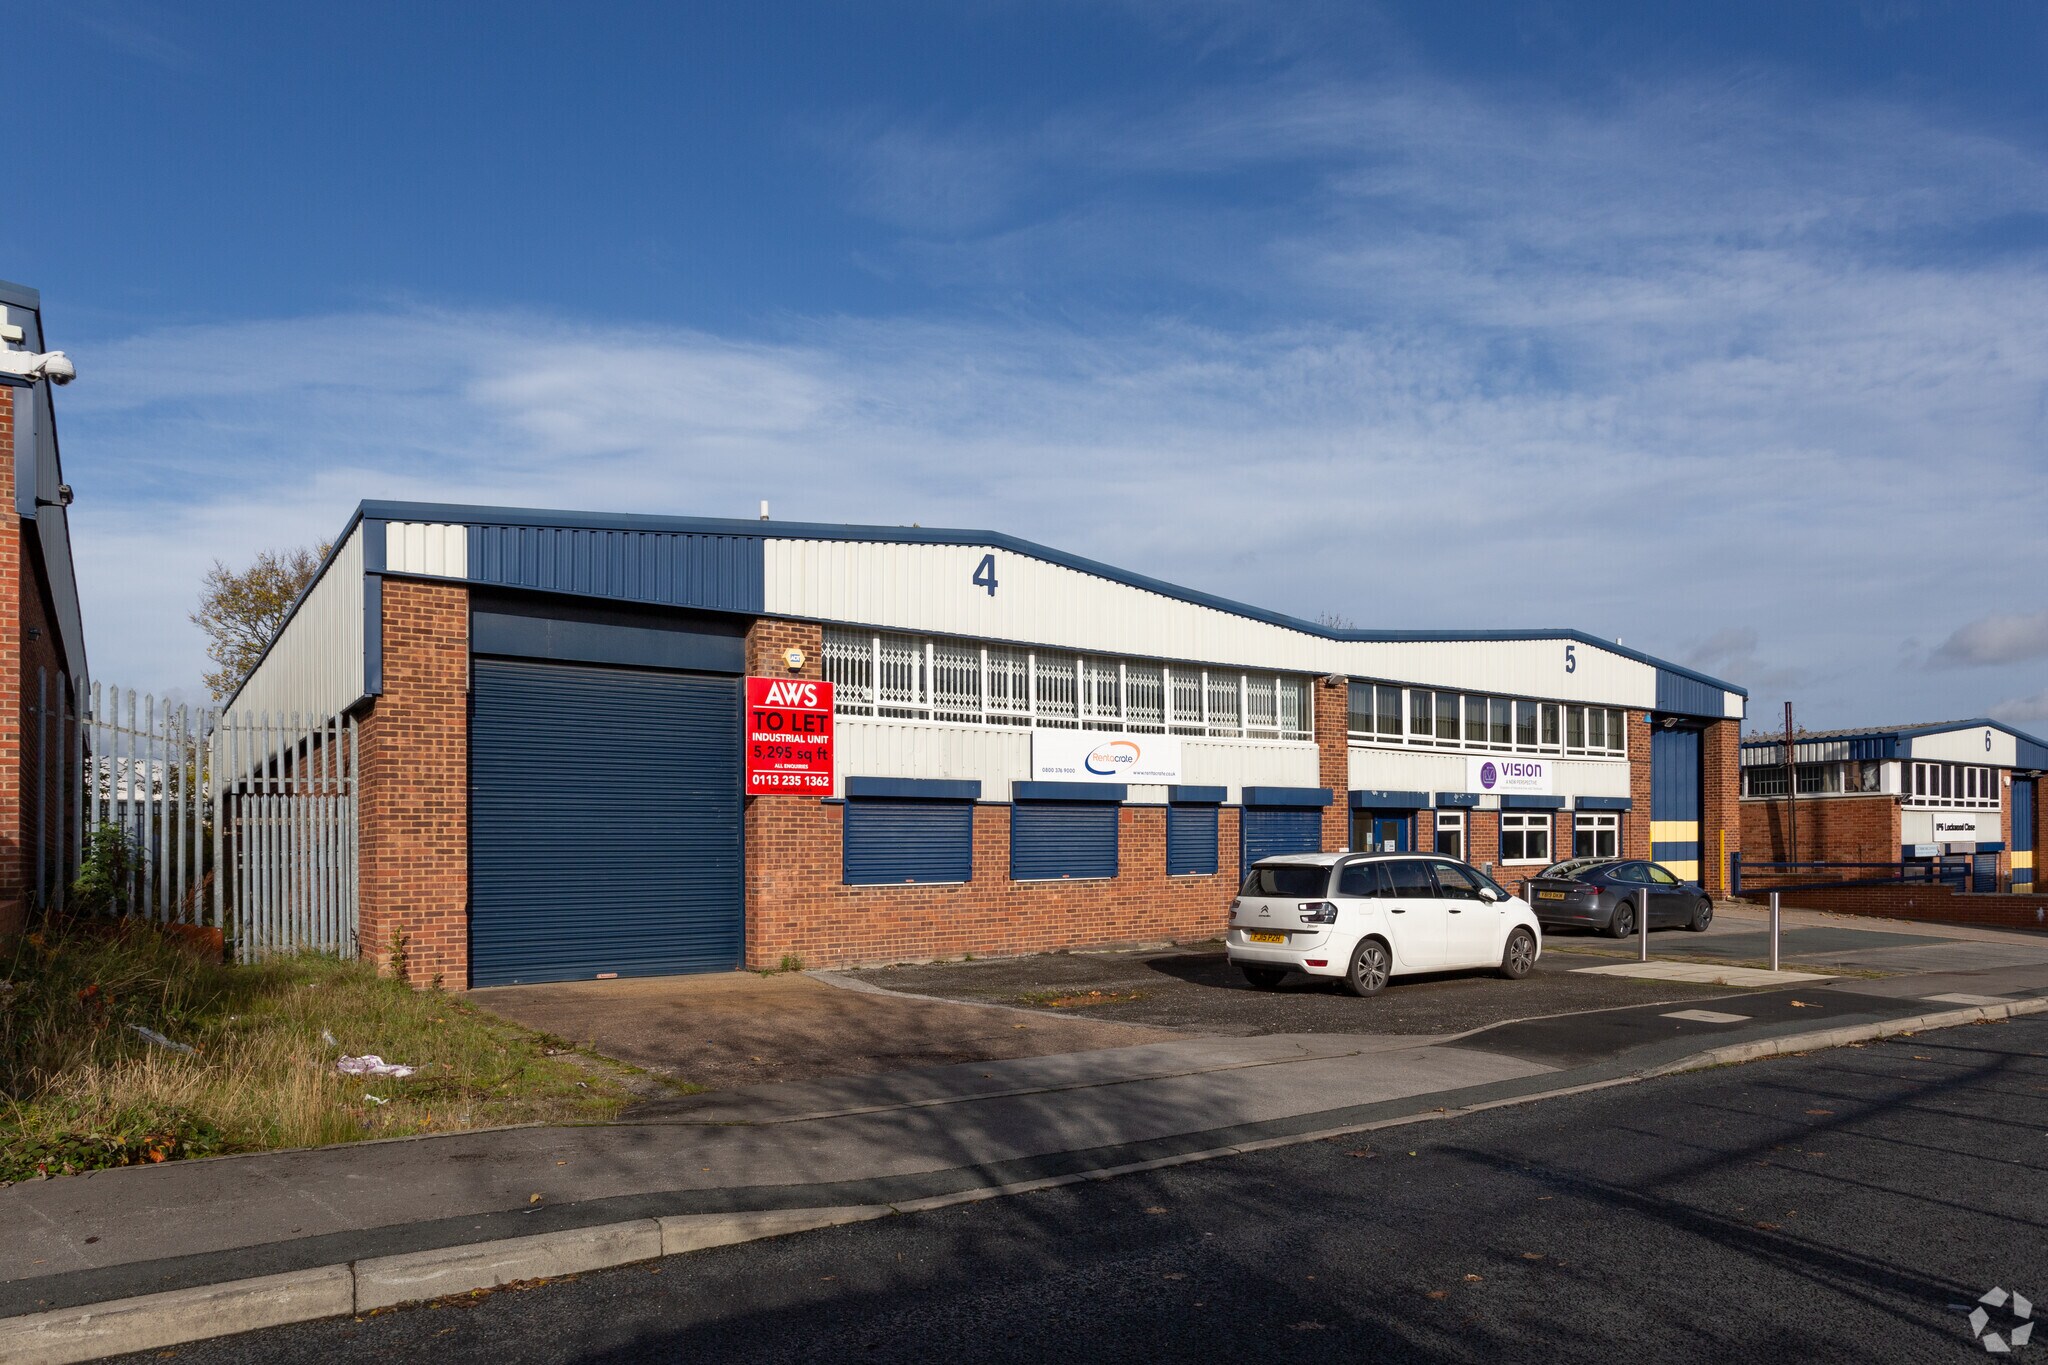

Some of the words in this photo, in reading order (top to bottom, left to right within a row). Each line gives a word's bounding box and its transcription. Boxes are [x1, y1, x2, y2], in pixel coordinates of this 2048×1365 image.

[973, 554, 998, 597] 4
[1566, 645, 1576, 674] 5
[765, 681, 818, 707] AWS
[753, 711, 784, 731] TO
[792, 714, 828, 732] LET
[752, 733, 806, 743] INDUSTRIAL
[807, 735, 829, 744] UNIT
[1985, 730, 1991, 751] 6
[754, 745, 792, 760] 5,295
[797, 750, 812, 763] sq
[817, 747, 828, 760] ft
[1092, 752, 1133, 764] Rentacrate
[752, 774, 779, 785] 0113
[782, 775, 801, 786] 235
[804, 776, 829, 787] 1362
